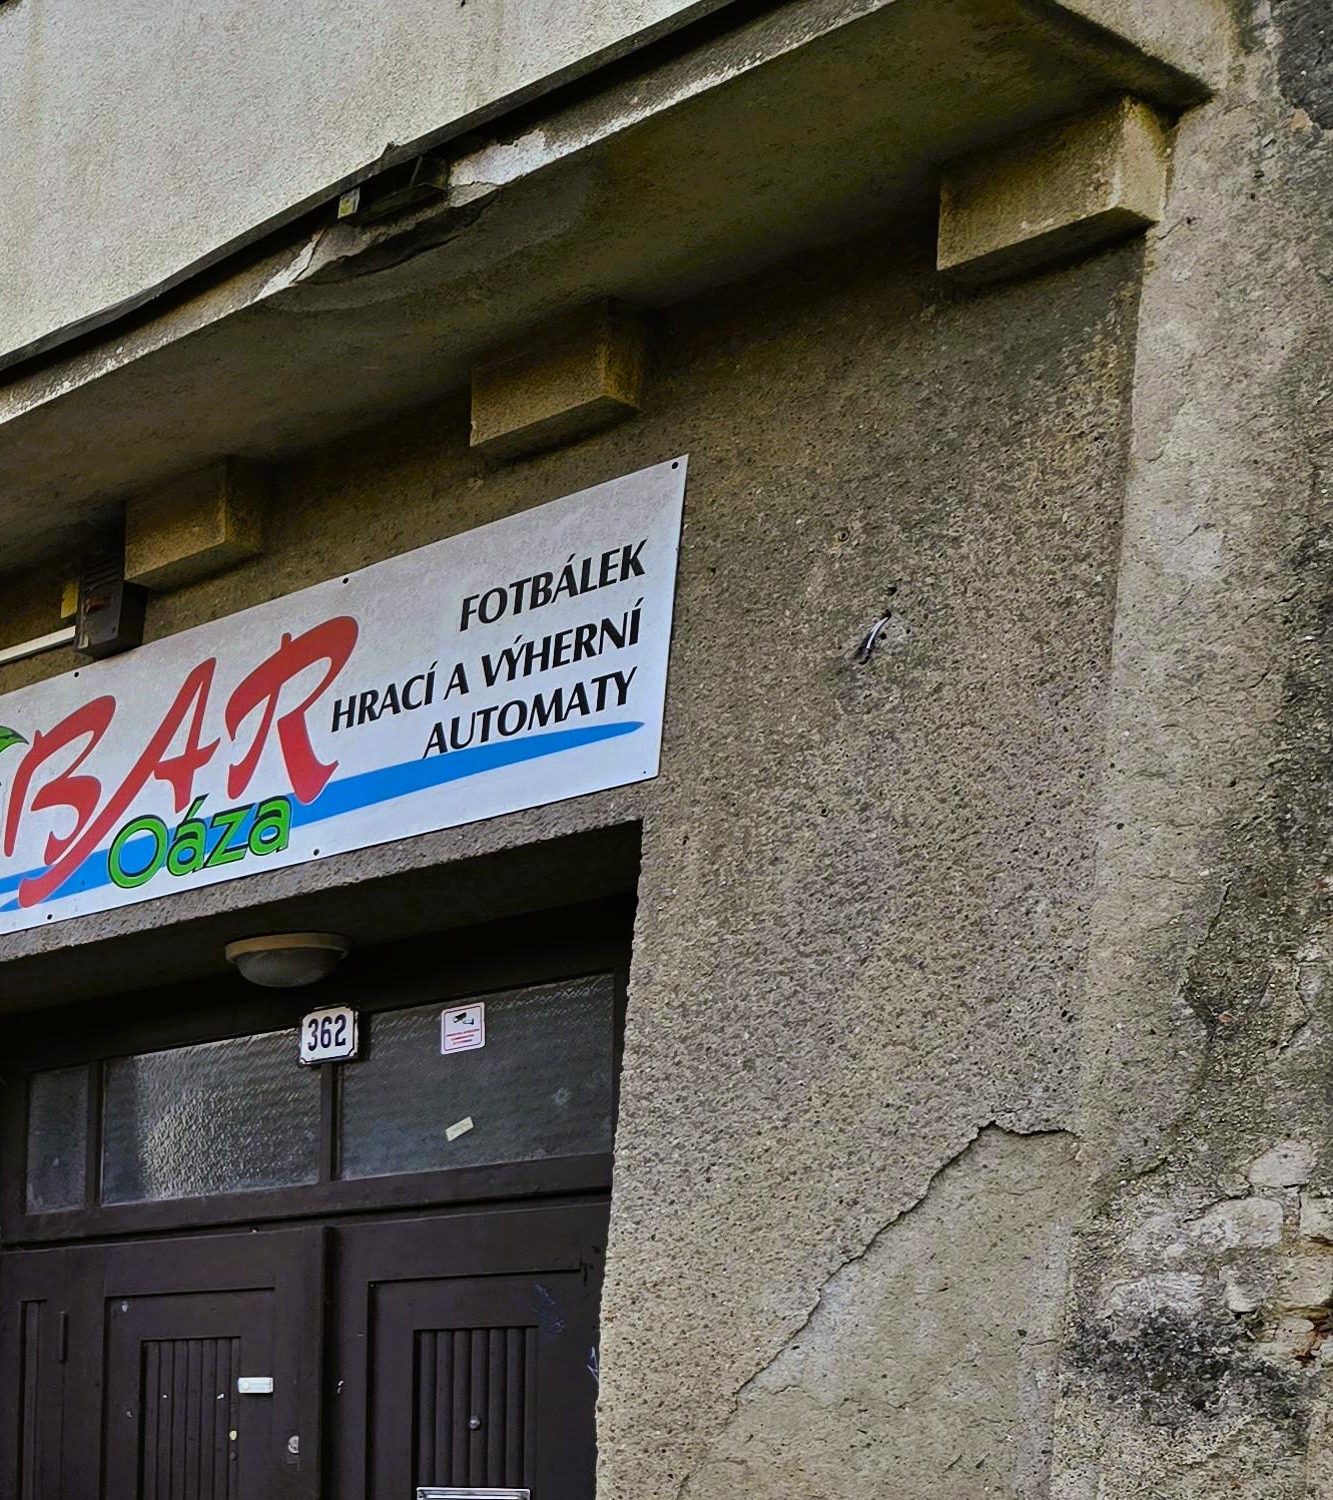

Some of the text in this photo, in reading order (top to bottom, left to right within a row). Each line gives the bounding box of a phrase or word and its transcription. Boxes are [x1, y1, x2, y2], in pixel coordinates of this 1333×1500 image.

[459, 538, 648, 633] FOTBÁLEK
[331, 596, 645, 733] HRACÍ A VÝHERNÍ
[422, 665, 638, 760] AUTOMATY
[4, 616, 359, 908] BAR
[107, 793, 293, 889] Oáza
[307, 1013, 347, 1052] 362
